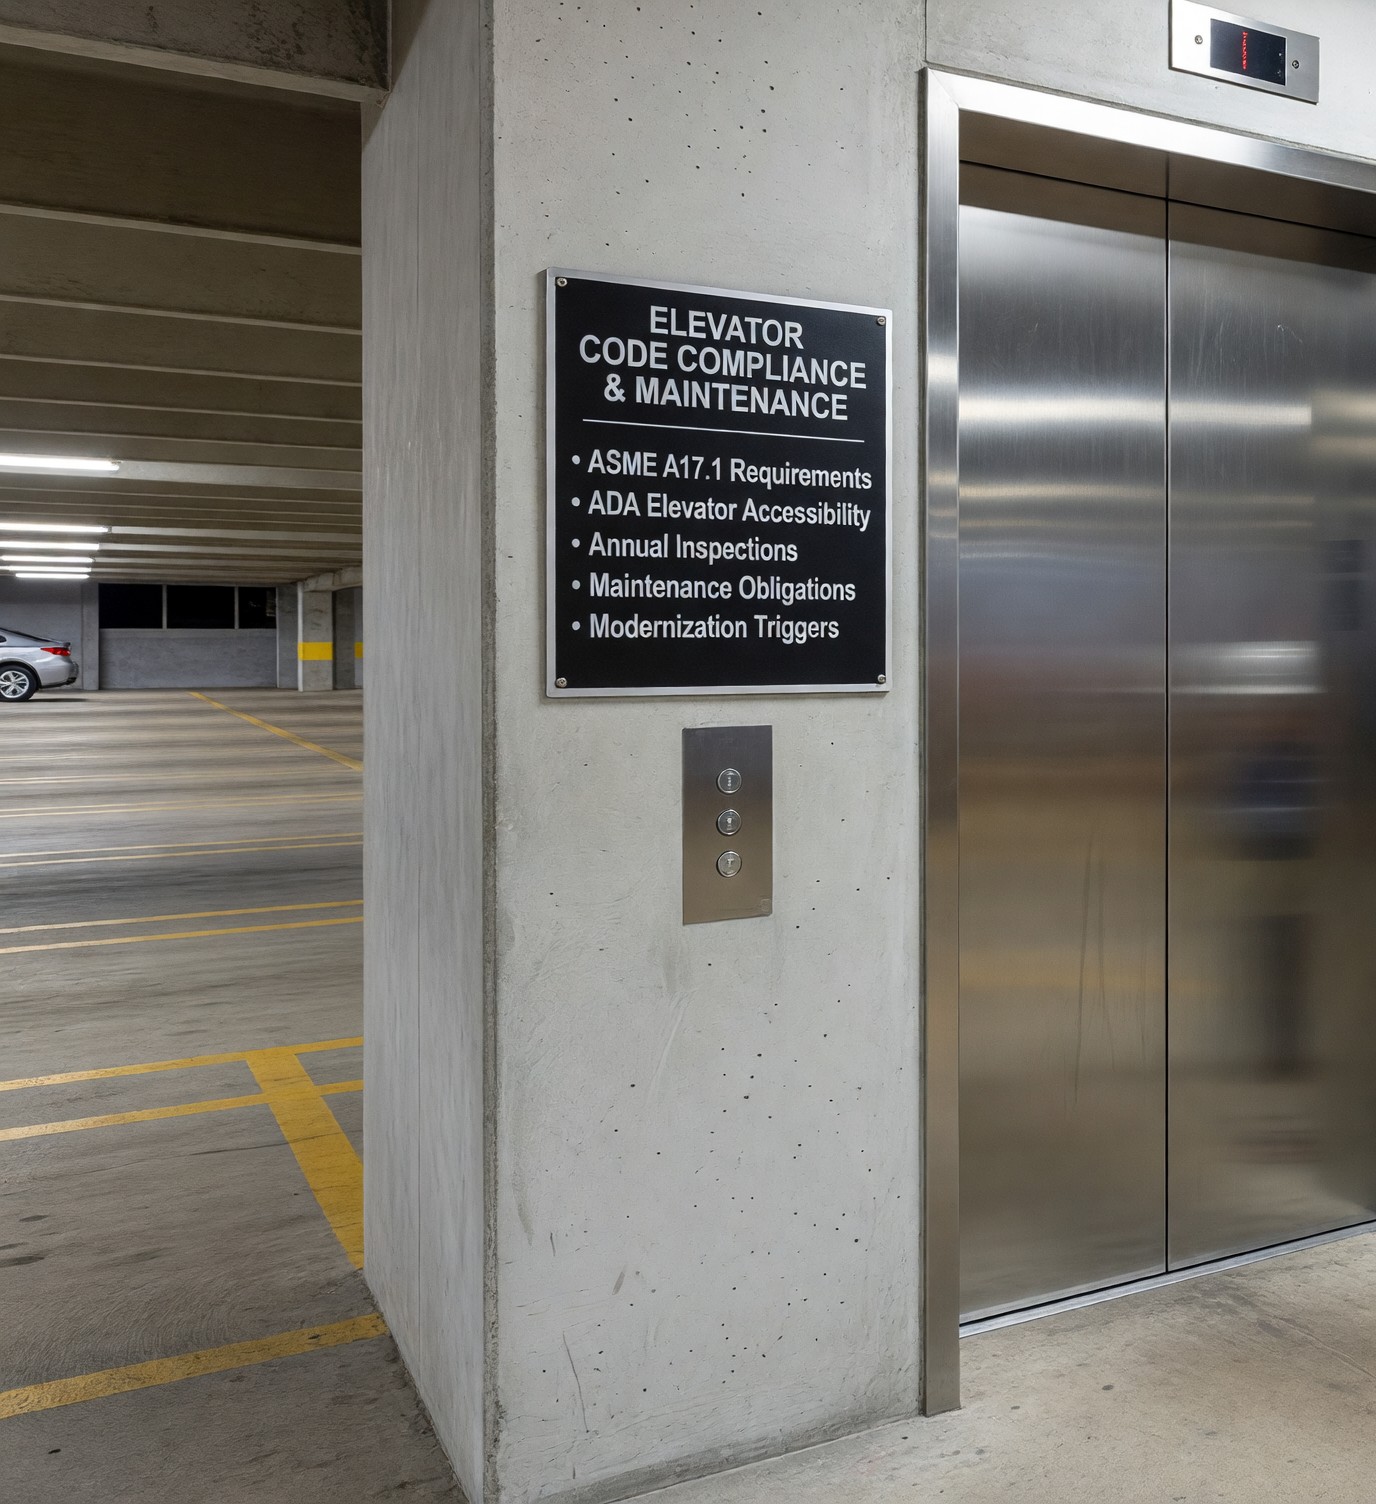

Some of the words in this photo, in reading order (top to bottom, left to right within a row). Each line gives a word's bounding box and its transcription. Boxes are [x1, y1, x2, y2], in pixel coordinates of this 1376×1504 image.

[650, 306, 804, 349] ELEVATOR
[579, 334, 668, 370] CODE
[677, 344, 868, 389] COMPLIANCE
[603, 373, 626, 403] &
[635, 375, 849, 420] MAINTENANCE
[587, 448, 658, 477] ASME
[662, 453, 722, 480] A17.1
[730, 457, 873, 490] Requirements
[587, 489, 641, 517] ADA
[647, 492, 738, 521] Elevator
[741, 497, 872, 533] Accessibility
[588, 531, 669, 558] Annual
[676, 533, 799, 566] Inspections
[589, 571, 733, 600] Maintenance
[738, 575, 856, 606] Obligations
[589, 613, 748, 639] Modernization
[753, 614, 840, 645] Triggers
